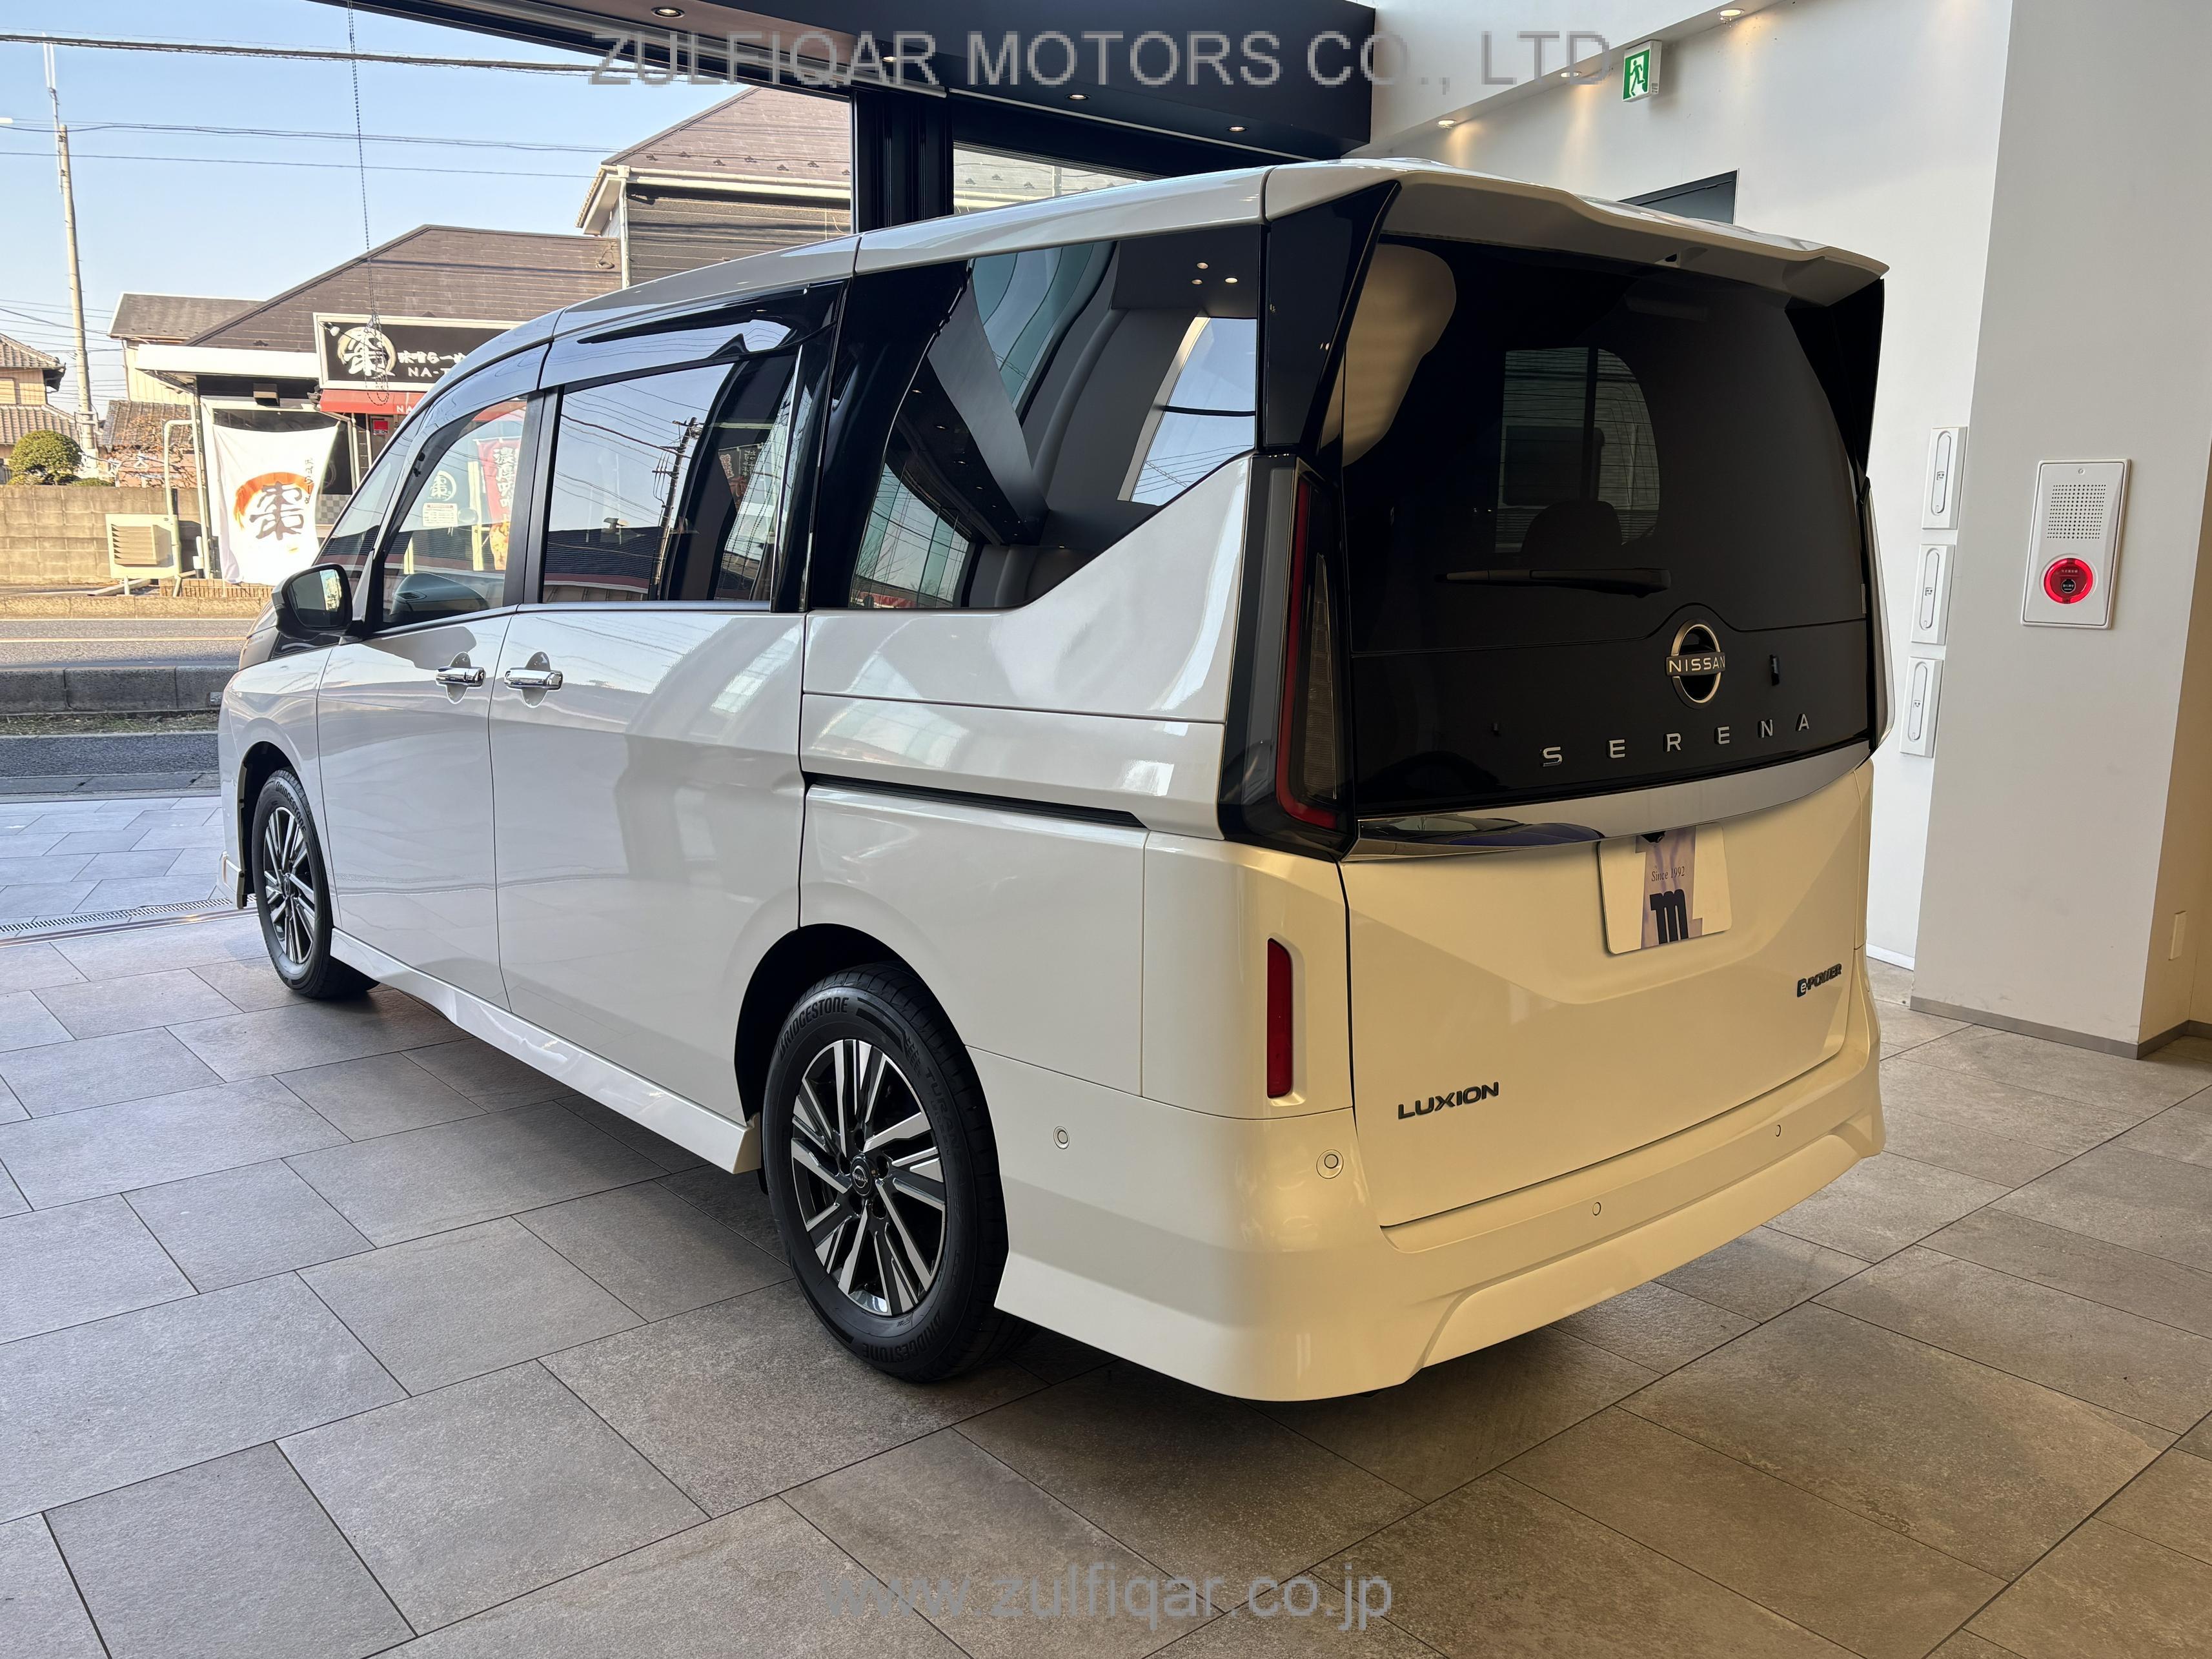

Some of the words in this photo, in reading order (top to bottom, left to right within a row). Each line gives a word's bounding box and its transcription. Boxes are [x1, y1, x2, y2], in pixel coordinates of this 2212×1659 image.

[1669, 655, 1725, 673] NISSAN
[1541, 713, 1811, 768] SERENA
[1651, 870, 1669, 882] Since
[1670, 866, 1685, 879] 1992
[778, 996, 849, 1061] BRIDGESTONE
[1397, 1081, 1499, 1120] LUXION
